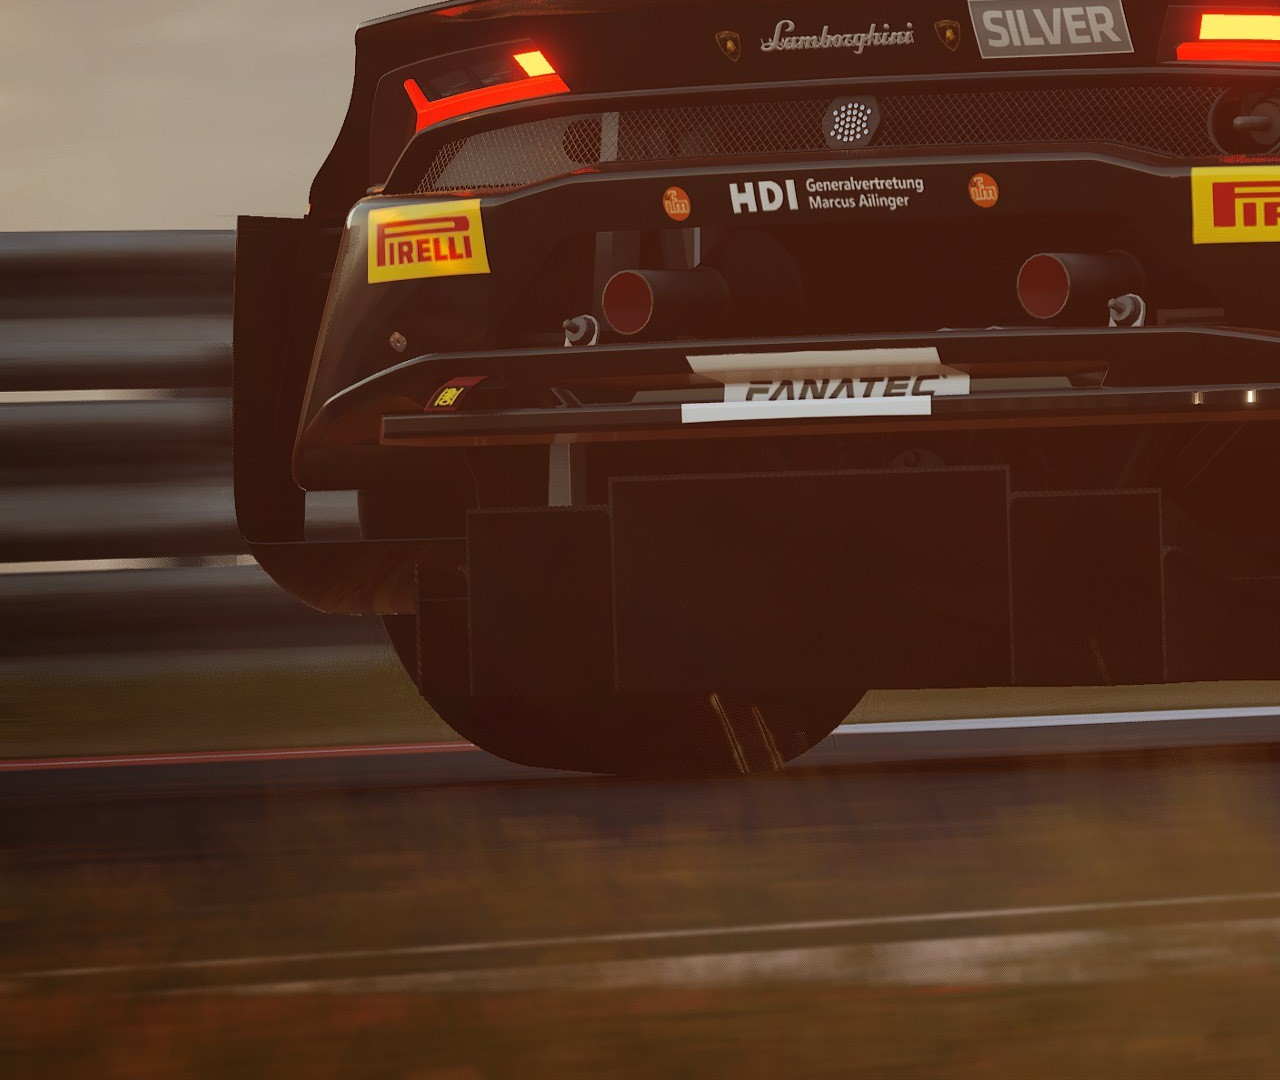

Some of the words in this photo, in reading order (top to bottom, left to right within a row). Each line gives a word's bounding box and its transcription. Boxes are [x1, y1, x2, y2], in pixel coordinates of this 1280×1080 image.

[760, 20, 915, 55] Lamborghini
[982, 5, 1122, 48] SILVER
[729, 179, 799, 214] HDI
[805, 176, 924, 193] Generalvertretung
[809, 195, 856, 210] Marcus
[858, 193, 910, 211] Ailinger
[377, 215, 472, 267] PIRELLI
[746, 374, 940, 401] FANATEC
